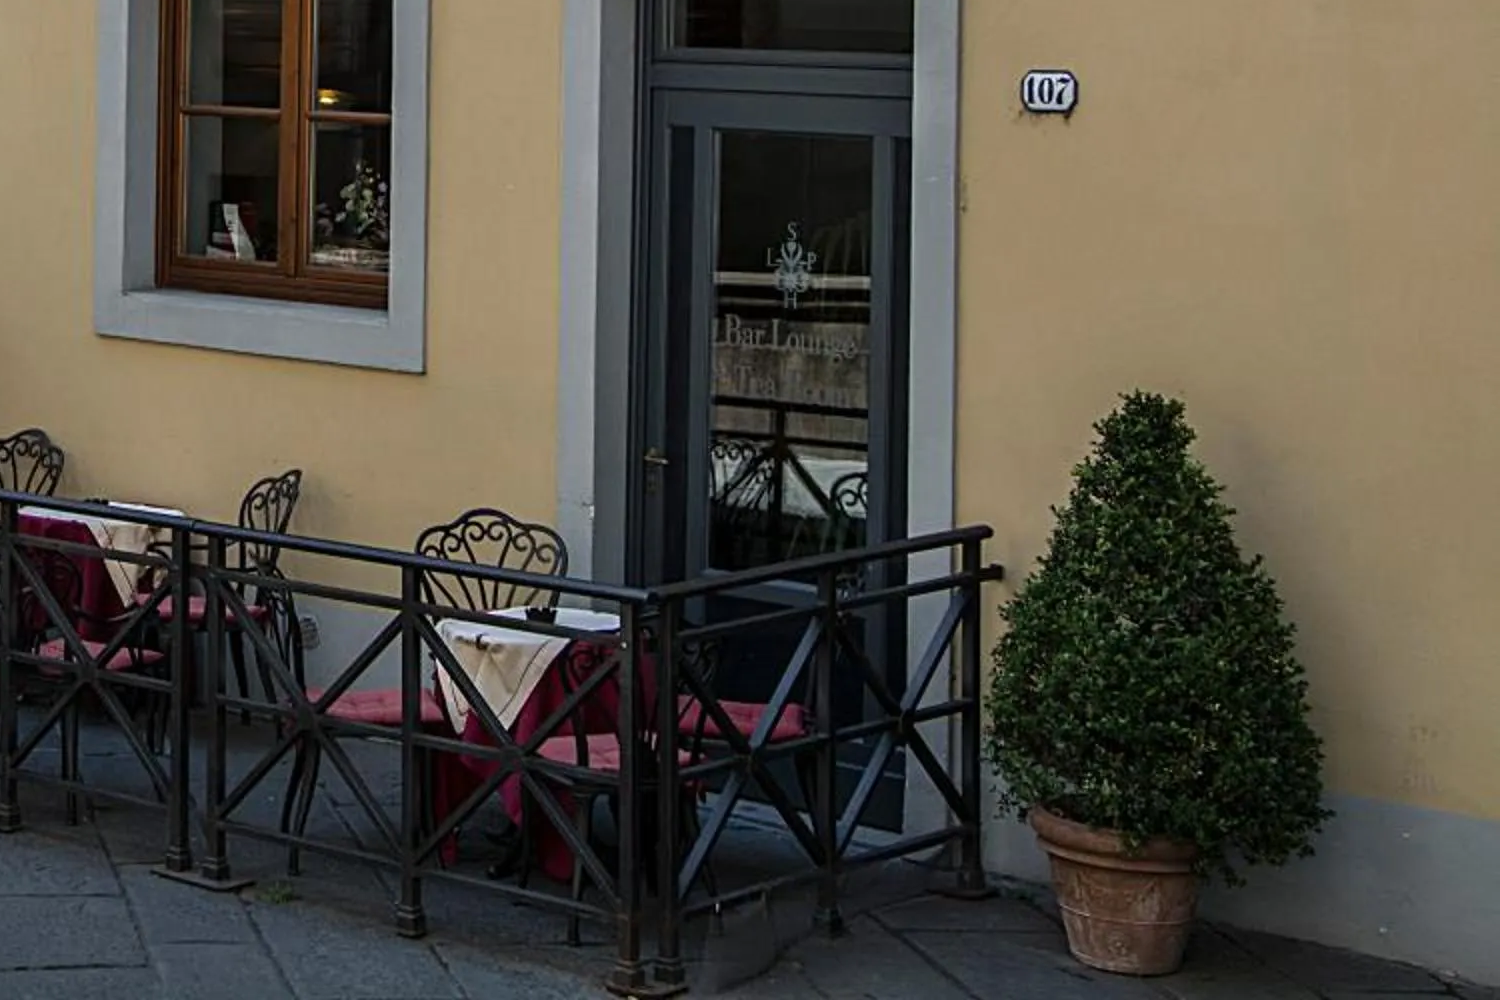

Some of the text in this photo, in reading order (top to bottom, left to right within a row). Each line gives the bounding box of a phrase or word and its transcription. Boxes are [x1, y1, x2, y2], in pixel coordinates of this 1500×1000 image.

[1027, 76, 1071, 105] 107
[787, 221, 797, 241] S
[807, 251, 818, 271] P
[784, 290, 797, 310] H
[725, 313, 858, 366] Bar Lounge
